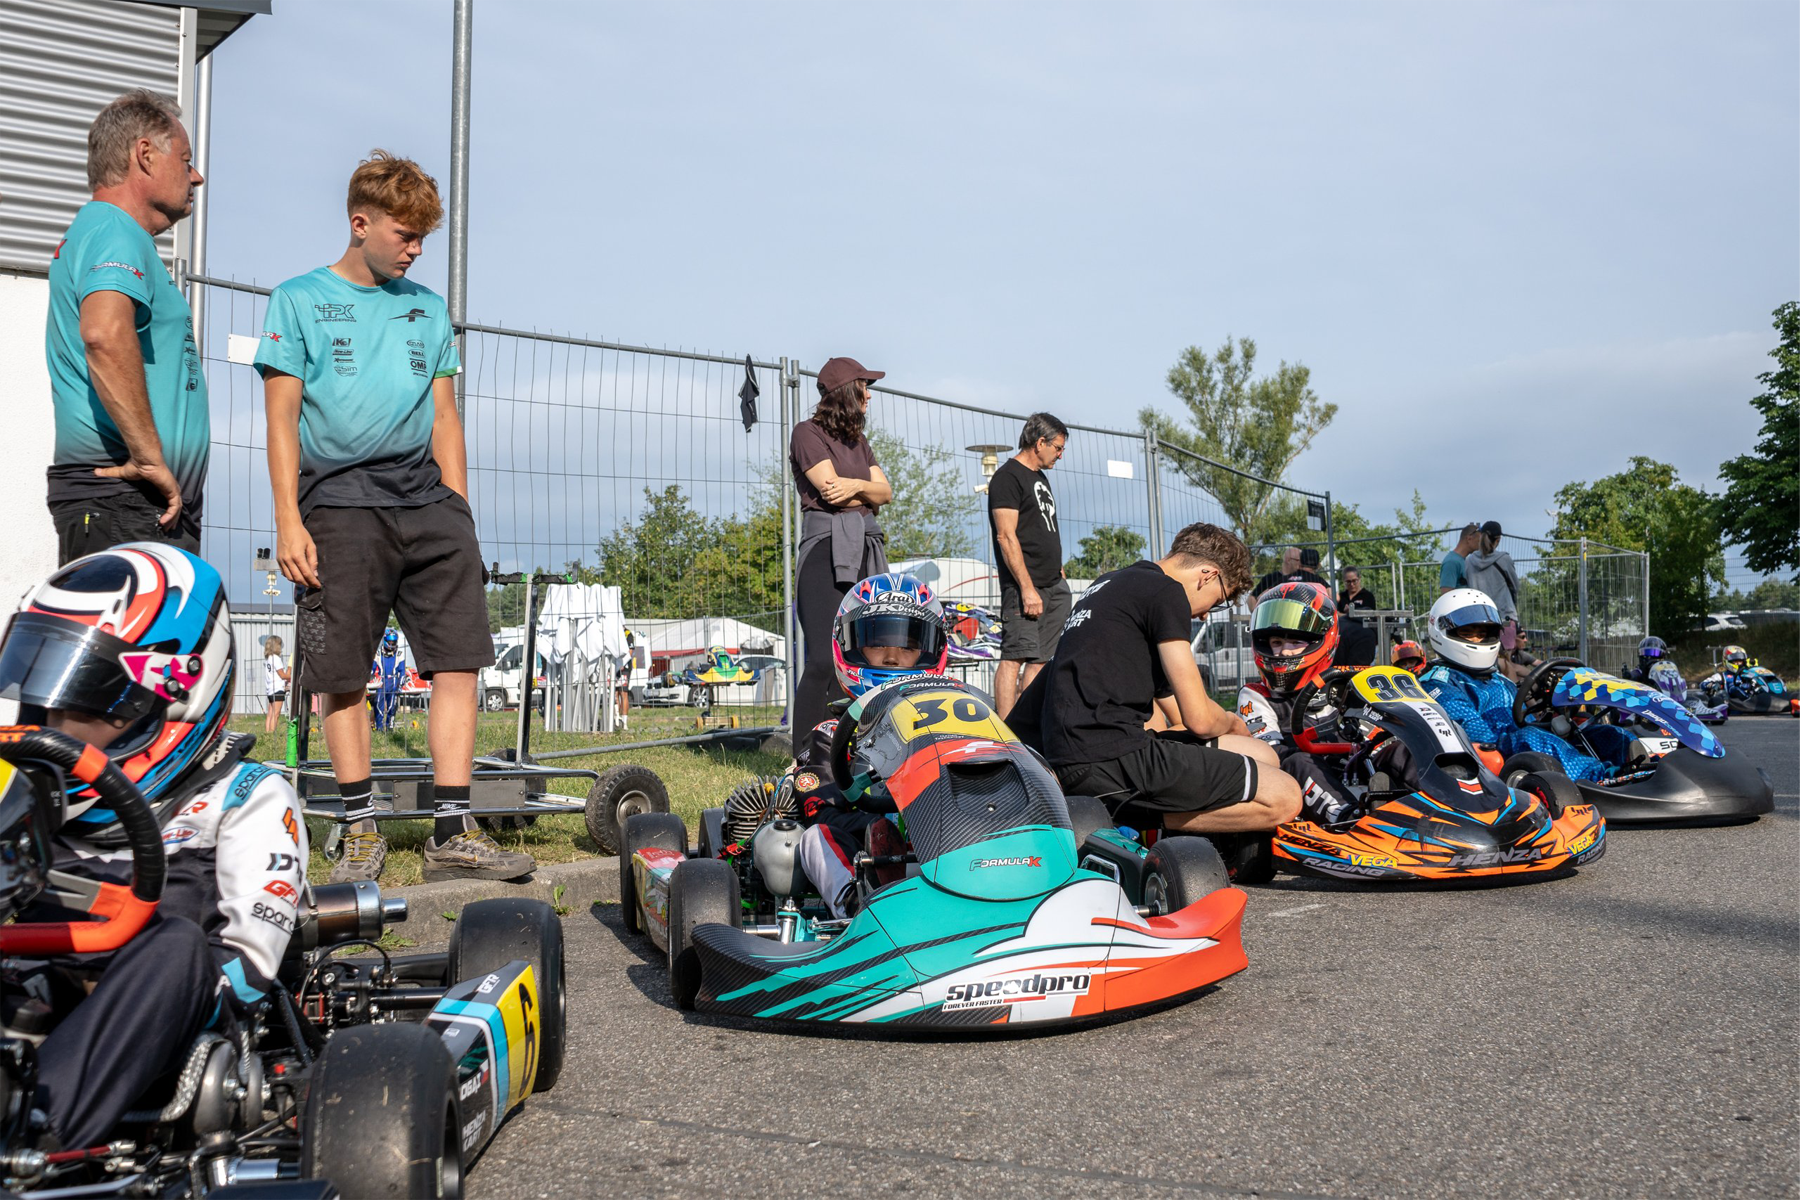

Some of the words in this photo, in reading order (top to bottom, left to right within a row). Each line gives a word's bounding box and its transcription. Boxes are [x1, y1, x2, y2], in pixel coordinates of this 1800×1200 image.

[879, 593, 912, 603] Arai
[1365, 674, 1428, 701] 36
[913, 698, 991, 731] 30
[234, 765, 270, 800] sparc
[1279, 834, 1342, 857] HENZA
[1569, 835, 1595, 857] VEGA
[969, 855, 1043, 872] FORMULAK
[1302, 857, 1386, 878] RACING
[1349, 854, 1398, 868] VEGA
[1447, 846, 1543, 868] HENZA
[251, 902, 296, 937] sparc
[943, 1001, 973, 1010] FOREVER
[972, 998, 1003, 1008] FASTER
